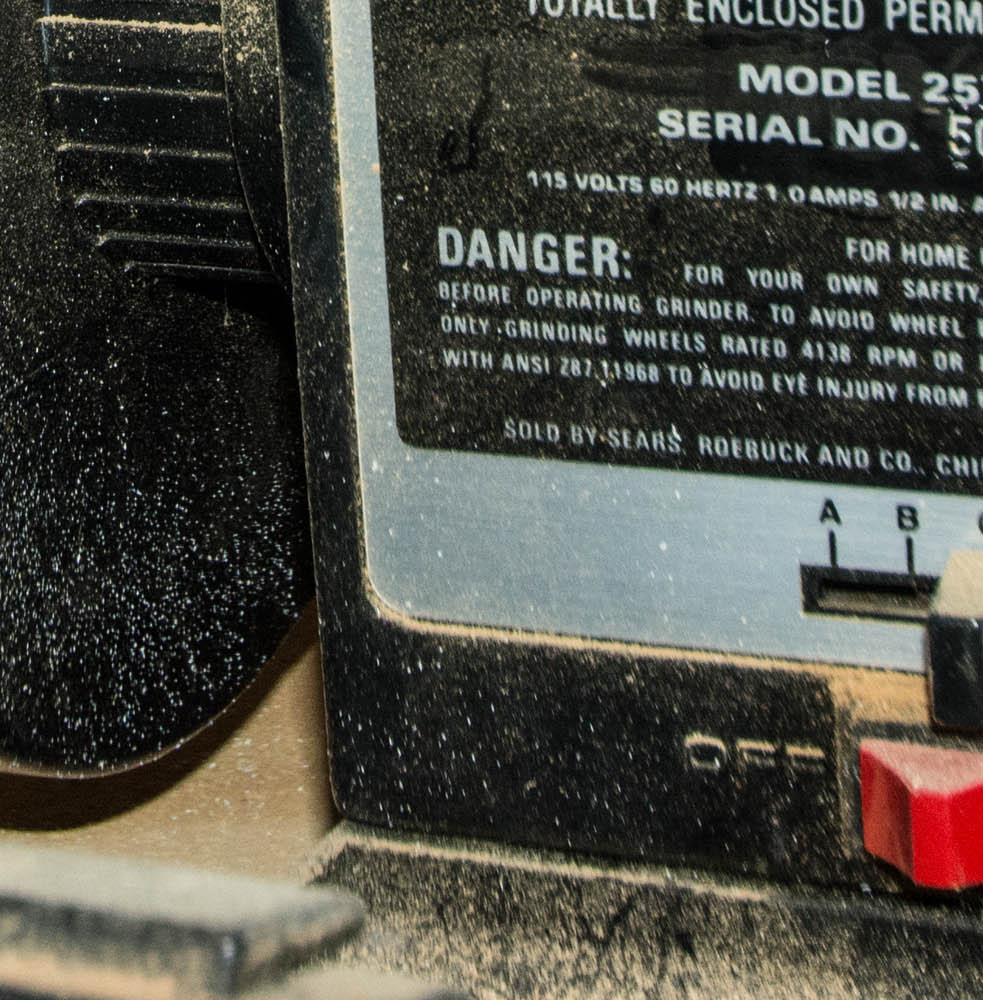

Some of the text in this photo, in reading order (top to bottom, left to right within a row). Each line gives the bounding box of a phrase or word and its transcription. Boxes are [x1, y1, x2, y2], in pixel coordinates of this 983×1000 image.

[738, 62, 983, 106] MODEL 25
[657, 107, 823, 147] SERIAL
[834, 117, 920, 152] NO.
[527, 169, 567, 190] 115
[574, 172, 643, 194] VOLTS
[649, 176, 679, 196] 60
[685, 179, 758, 201] HERTZ
[809, 185, 879, 208] AMPS
[438, 226, 632, 280] DANGER:
[683, 264, 724, 287] FOR
[746, 267, 804, 292] YOUR
[826, 272, 879, 297] OWN
[845, 237, 890, 264] FOR
[900, 241, 972, 272] HOME
[439, 281, 511, 304] BEFORE
[526, 287, 641, 315] OPERATING
[769, 303, 795, 325] TO
[809, 306, 875, 331] AVOID
[889, 312, 965, 338] WHEEL
[440, 315, 489, 335] ONLY
[505, 319, 608, 345] GRINDING
[622, 327, 706, 352] WHEELS
[721, 333, 787, 359] RATED
[800, 340, 852, 364] 4138
[867, 345, 917, 368] RPM
[932, 351, 964, 373] OR
[442, 350, 493, 370] WITH
[502, 354, 550, 375] ANSI
[667, 364, 693, 387] TO
[700, 367, 764, 392] AVOID
[772, 372, 808, 396] EYE
[817, 377, 897, 402] INJURY
[905, 383, 969, 408] FROM
[504, 417, 560, 443] SOLD
[570, 425, 597, 446] BY
[698, 433, 810, 464] ROEBUCK
[818, 444, 869, 470] AND
[820, 499, 920, 531] A B
